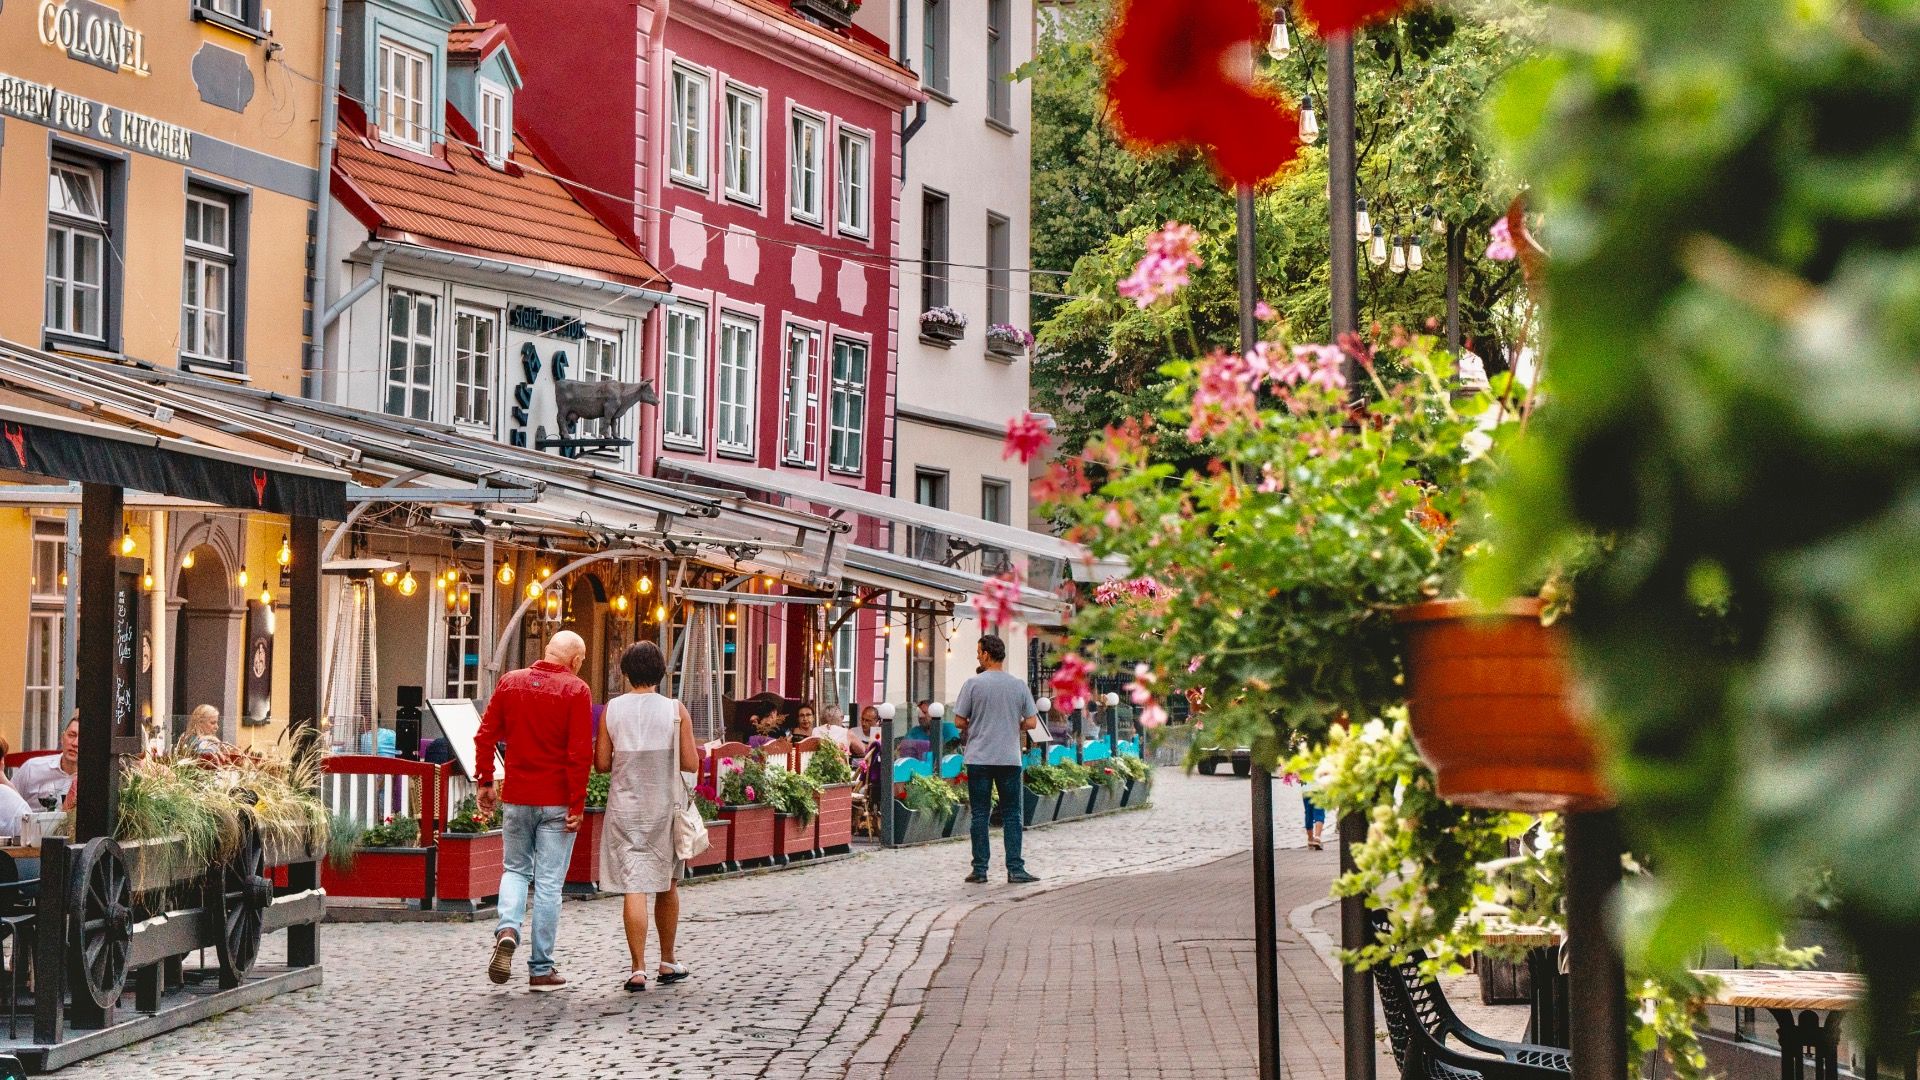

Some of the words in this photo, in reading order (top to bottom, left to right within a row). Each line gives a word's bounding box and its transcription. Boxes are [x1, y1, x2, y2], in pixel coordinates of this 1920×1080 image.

[39, 2, 152, 76] COLONEL
[2, 78, 56, 118] BREW
[58, 95, 92, 130] PUB
[100, 106, 114, 138] &
[122, 113, 192, 160] KITCHEN
